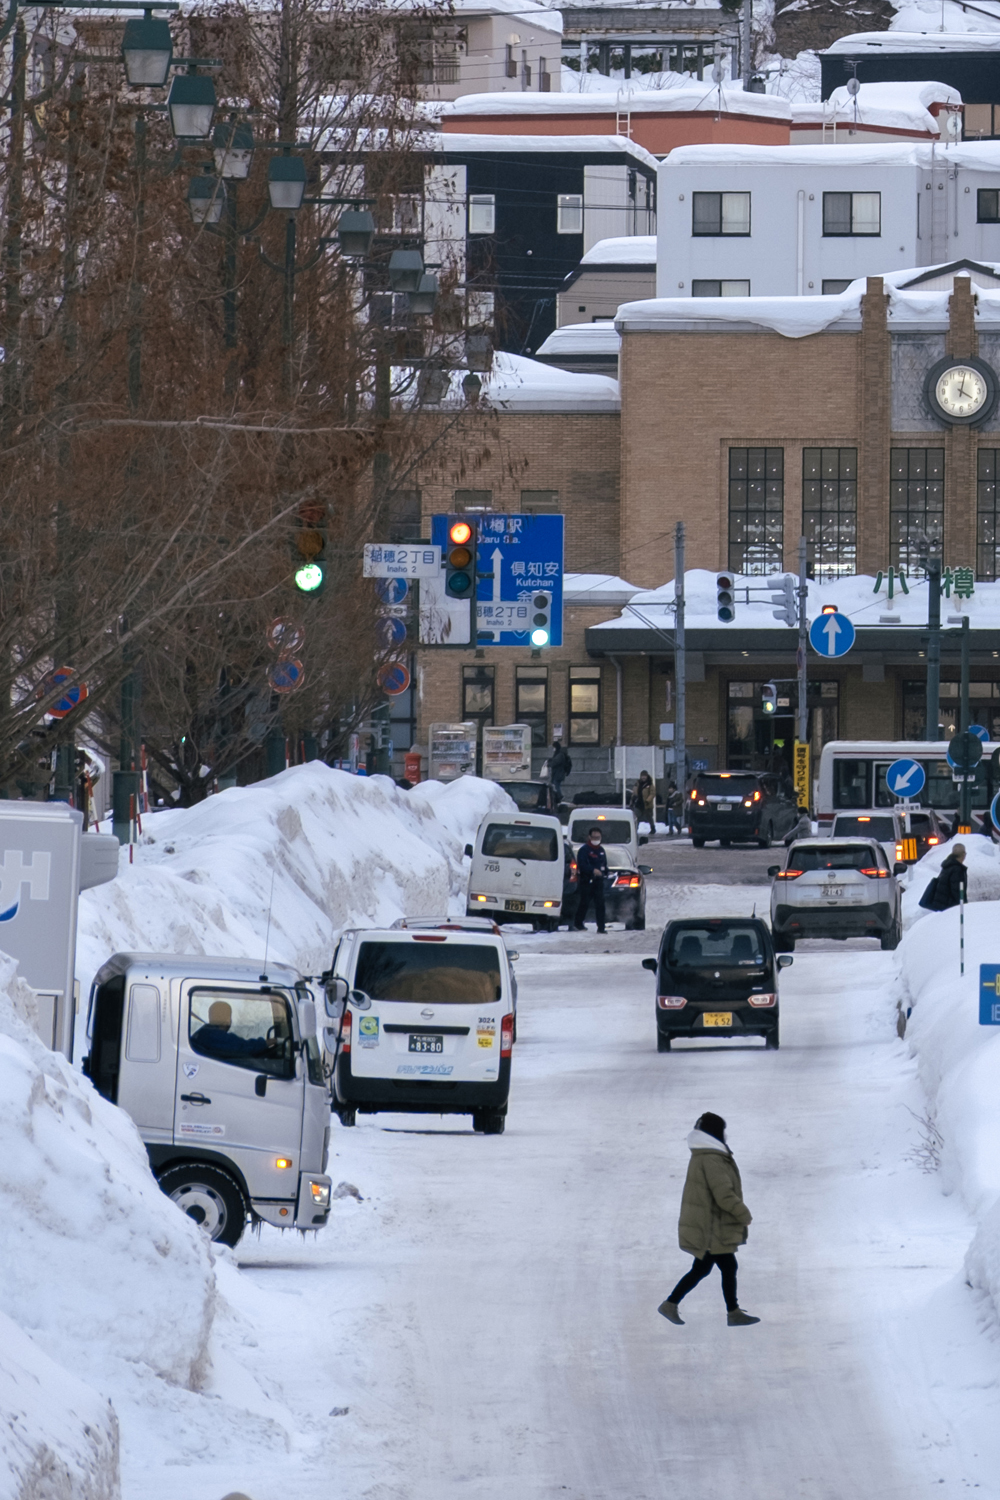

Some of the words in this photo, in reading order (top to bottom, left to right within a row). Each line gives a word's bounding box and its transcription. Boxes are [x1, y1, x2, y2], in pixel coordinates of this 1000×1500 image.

[370, 548, 435, 564] 稲穂2丁目
[386, 565, 408, 574] Inaho
[510, 561, 559, 577] 倶知安
[516, 577, 554, 587] Kutchan
[507, 619, 513, 627] 2
[484, 863, 500, 873] 768
